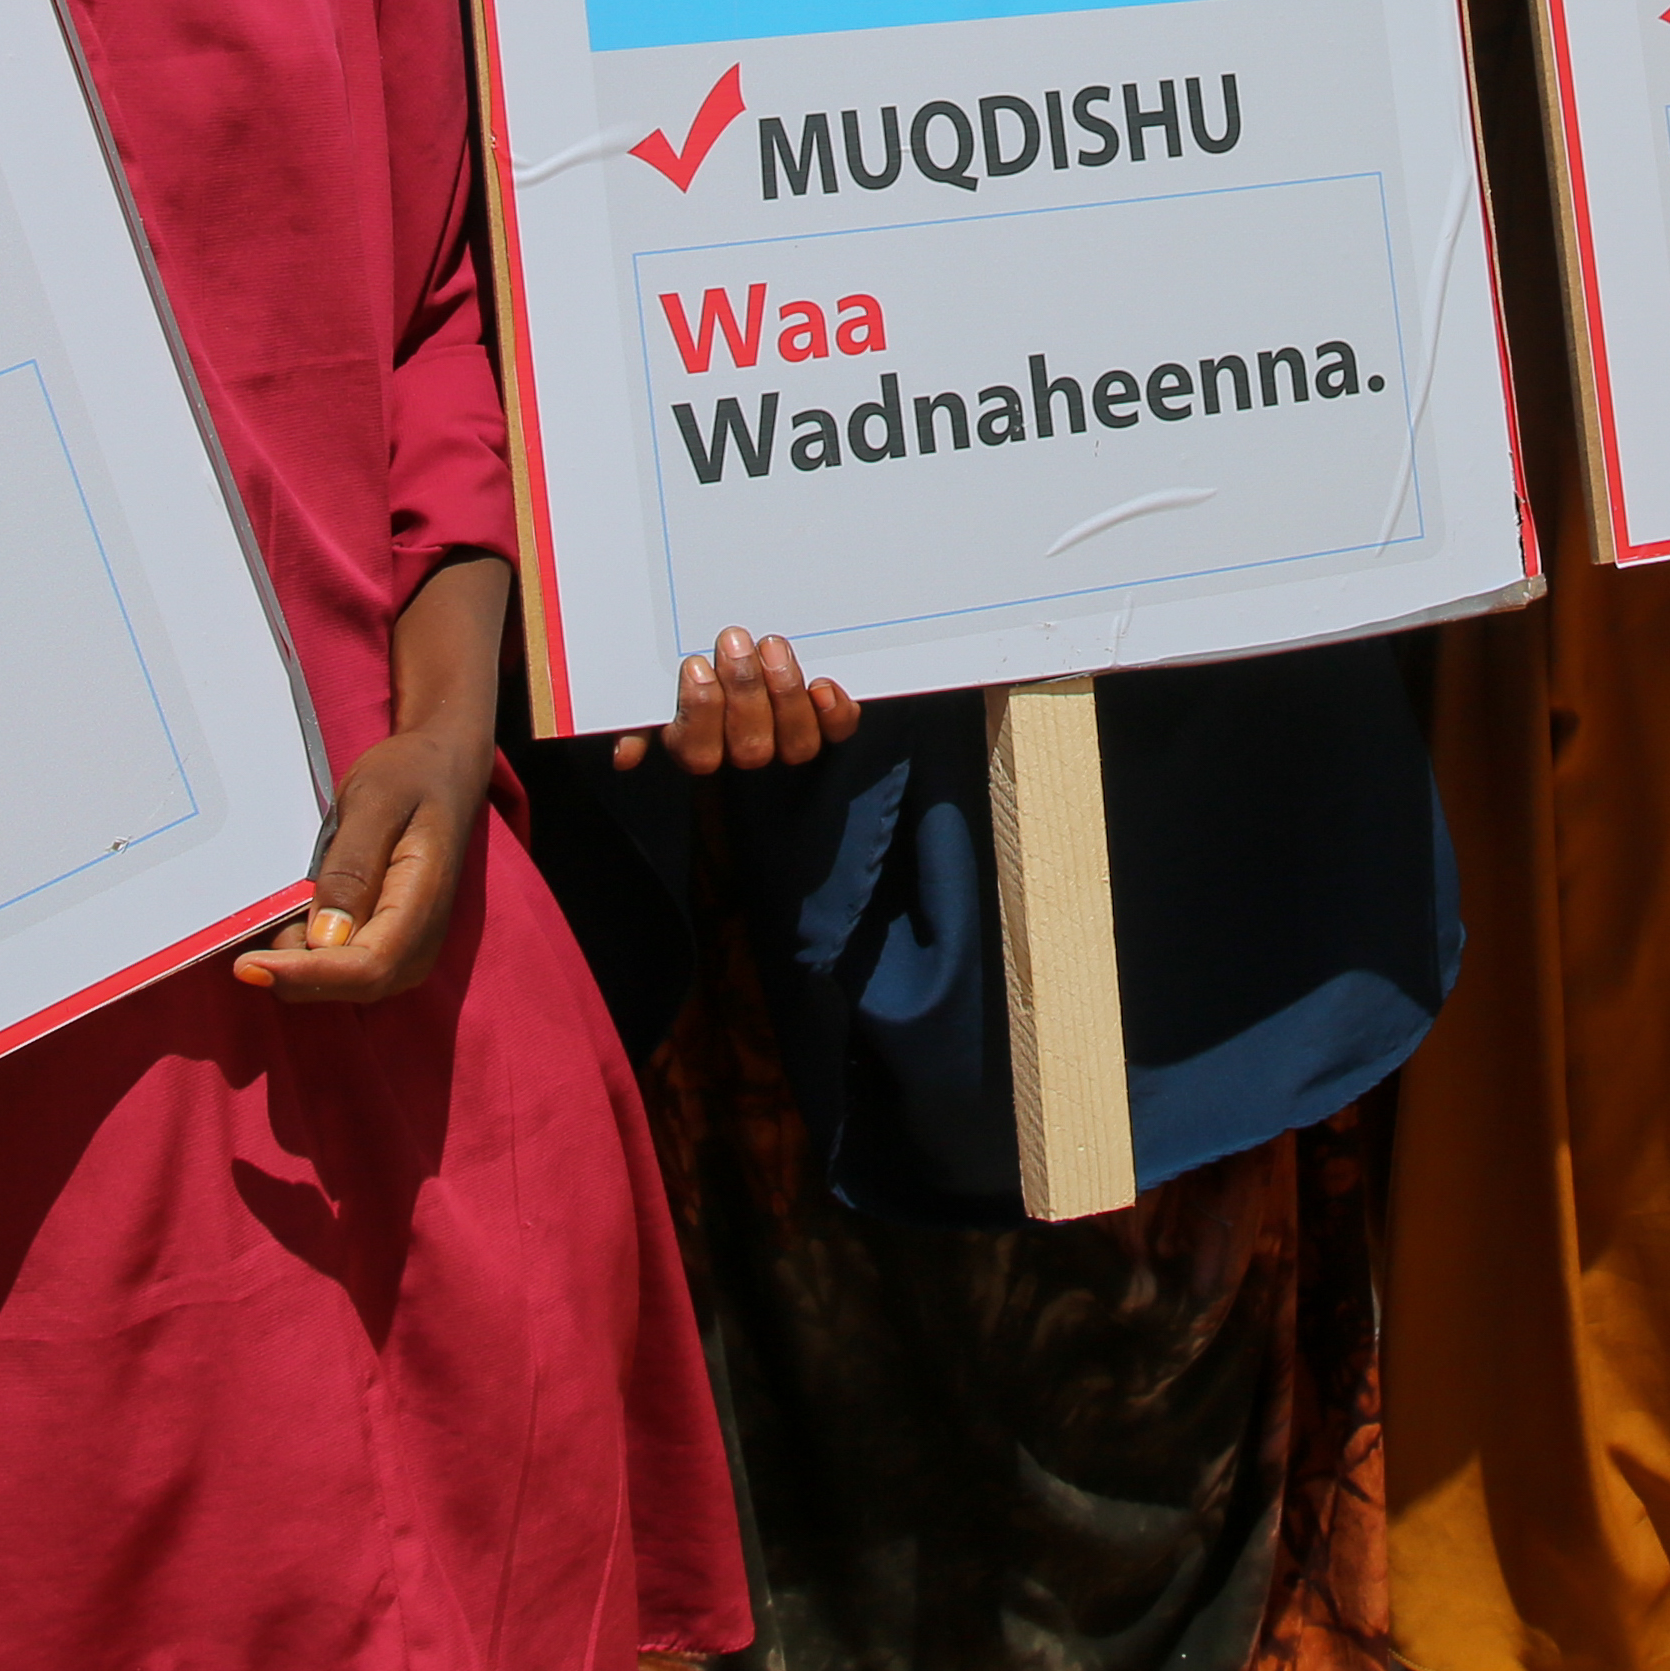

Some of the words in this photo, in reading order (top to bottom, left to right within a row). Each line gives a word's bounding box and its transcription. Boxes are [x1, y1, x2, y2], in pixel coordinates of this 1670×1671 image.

[758, 73, 1243, 201] MUQDISHU
[658, 282, 888, 374] Waa
[671, 339, 1387, 486] Wadnaheenna.
